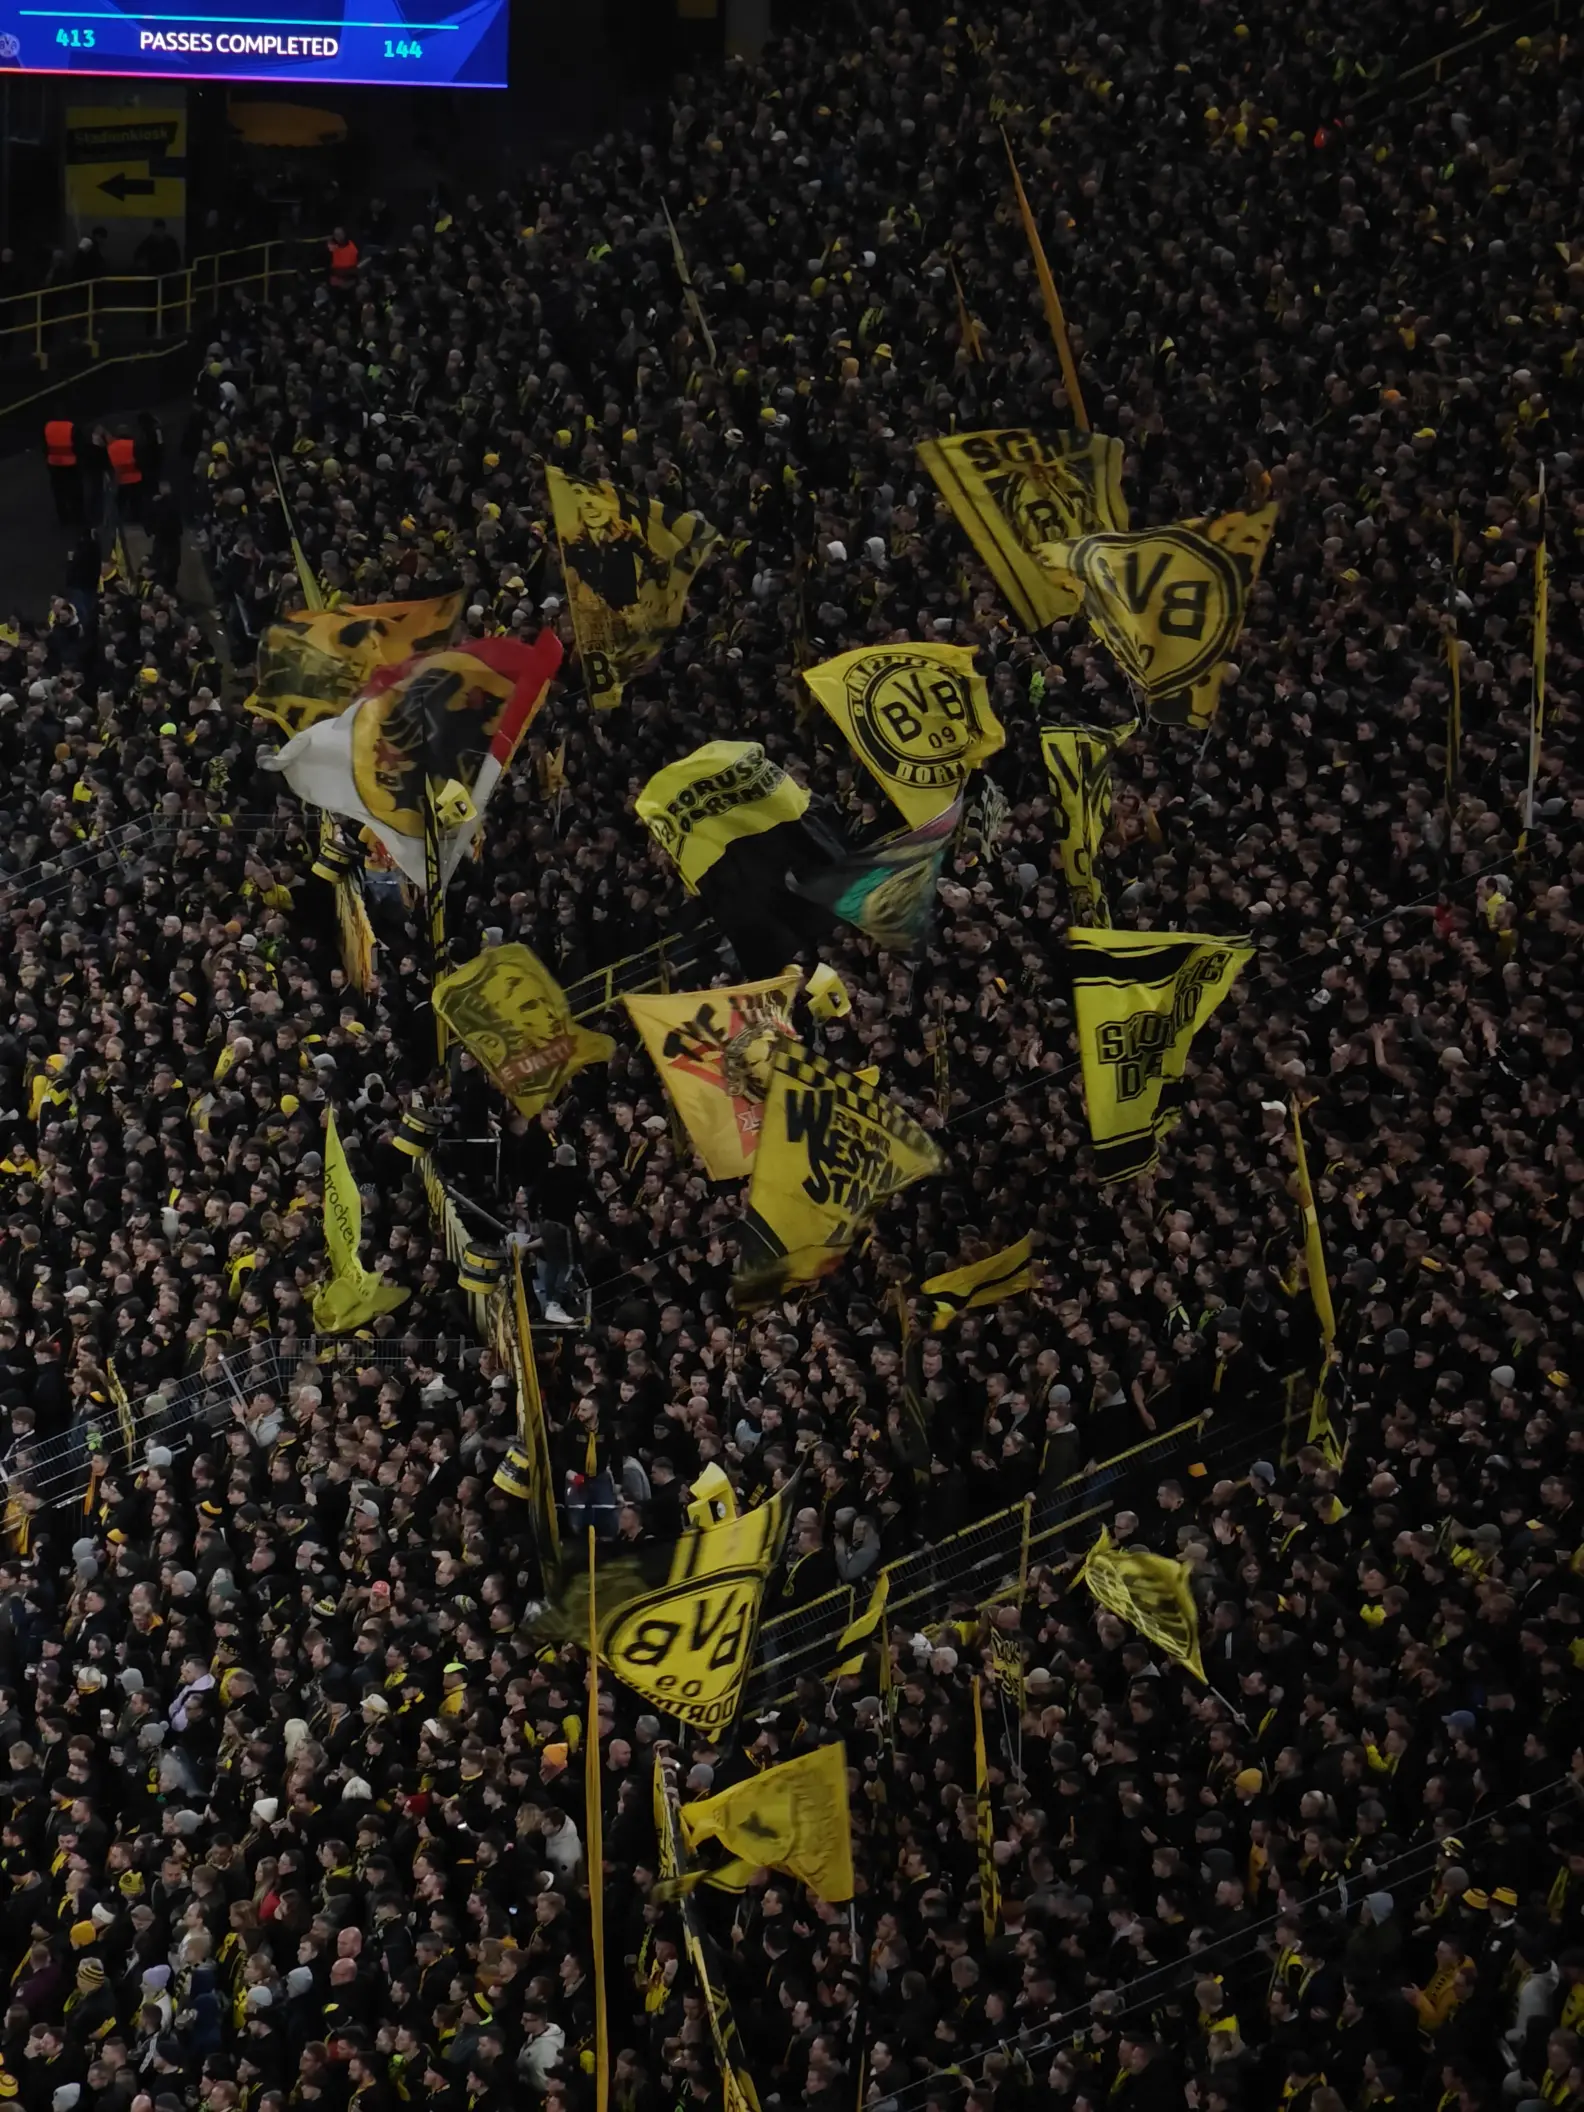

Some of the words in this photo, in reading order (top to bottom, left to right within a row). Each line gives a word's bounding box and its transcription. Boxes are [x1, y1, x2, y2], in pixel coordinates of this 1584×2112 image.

[56, 28, 96, 48] 413
[140, 31, 213, 52] PASSES
[215, 34, 339, 57] COMPLETED
[383, 39, 423, 59] 144
[880, 672, 965, 744] BVB
[928, 726, 957, 749] 09
